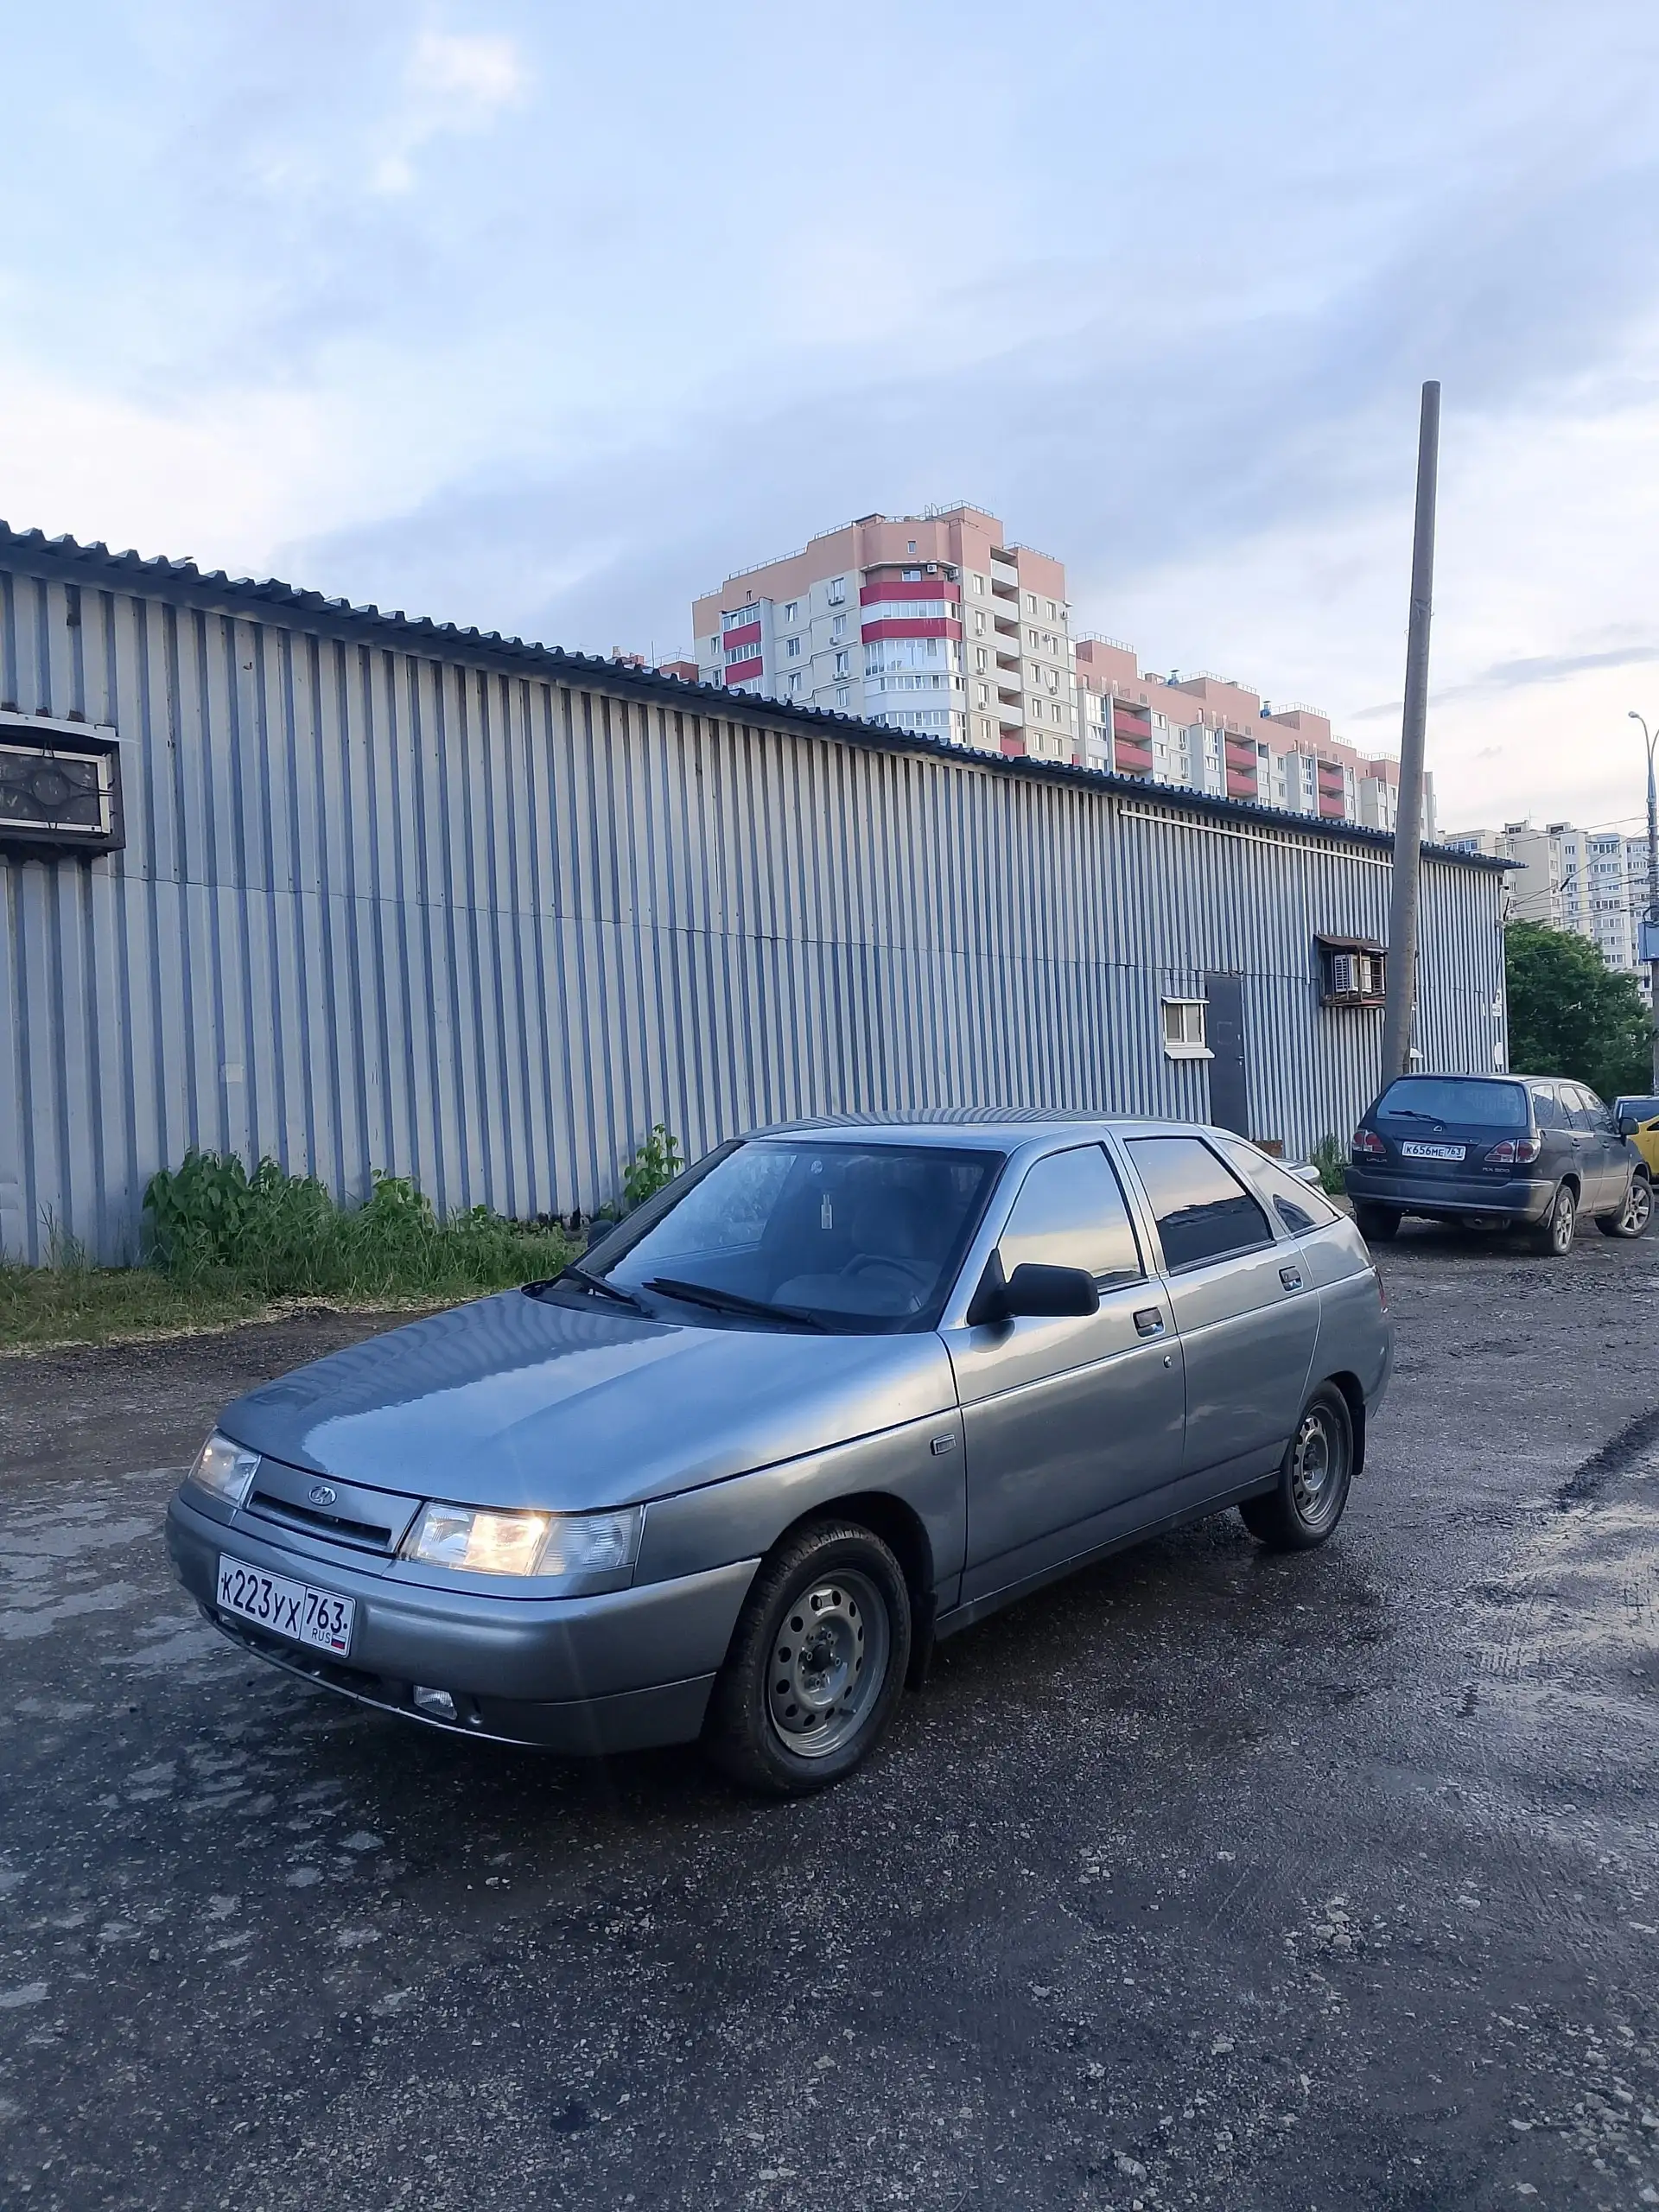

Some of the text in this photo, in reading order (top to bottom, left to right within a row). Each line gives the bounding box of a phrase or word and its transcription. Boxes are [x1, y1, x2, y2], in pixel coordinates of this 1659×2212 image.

[222, 1569, 345, 1633] К223УХ 763
[311, 1628, 331, 1644] RUS
